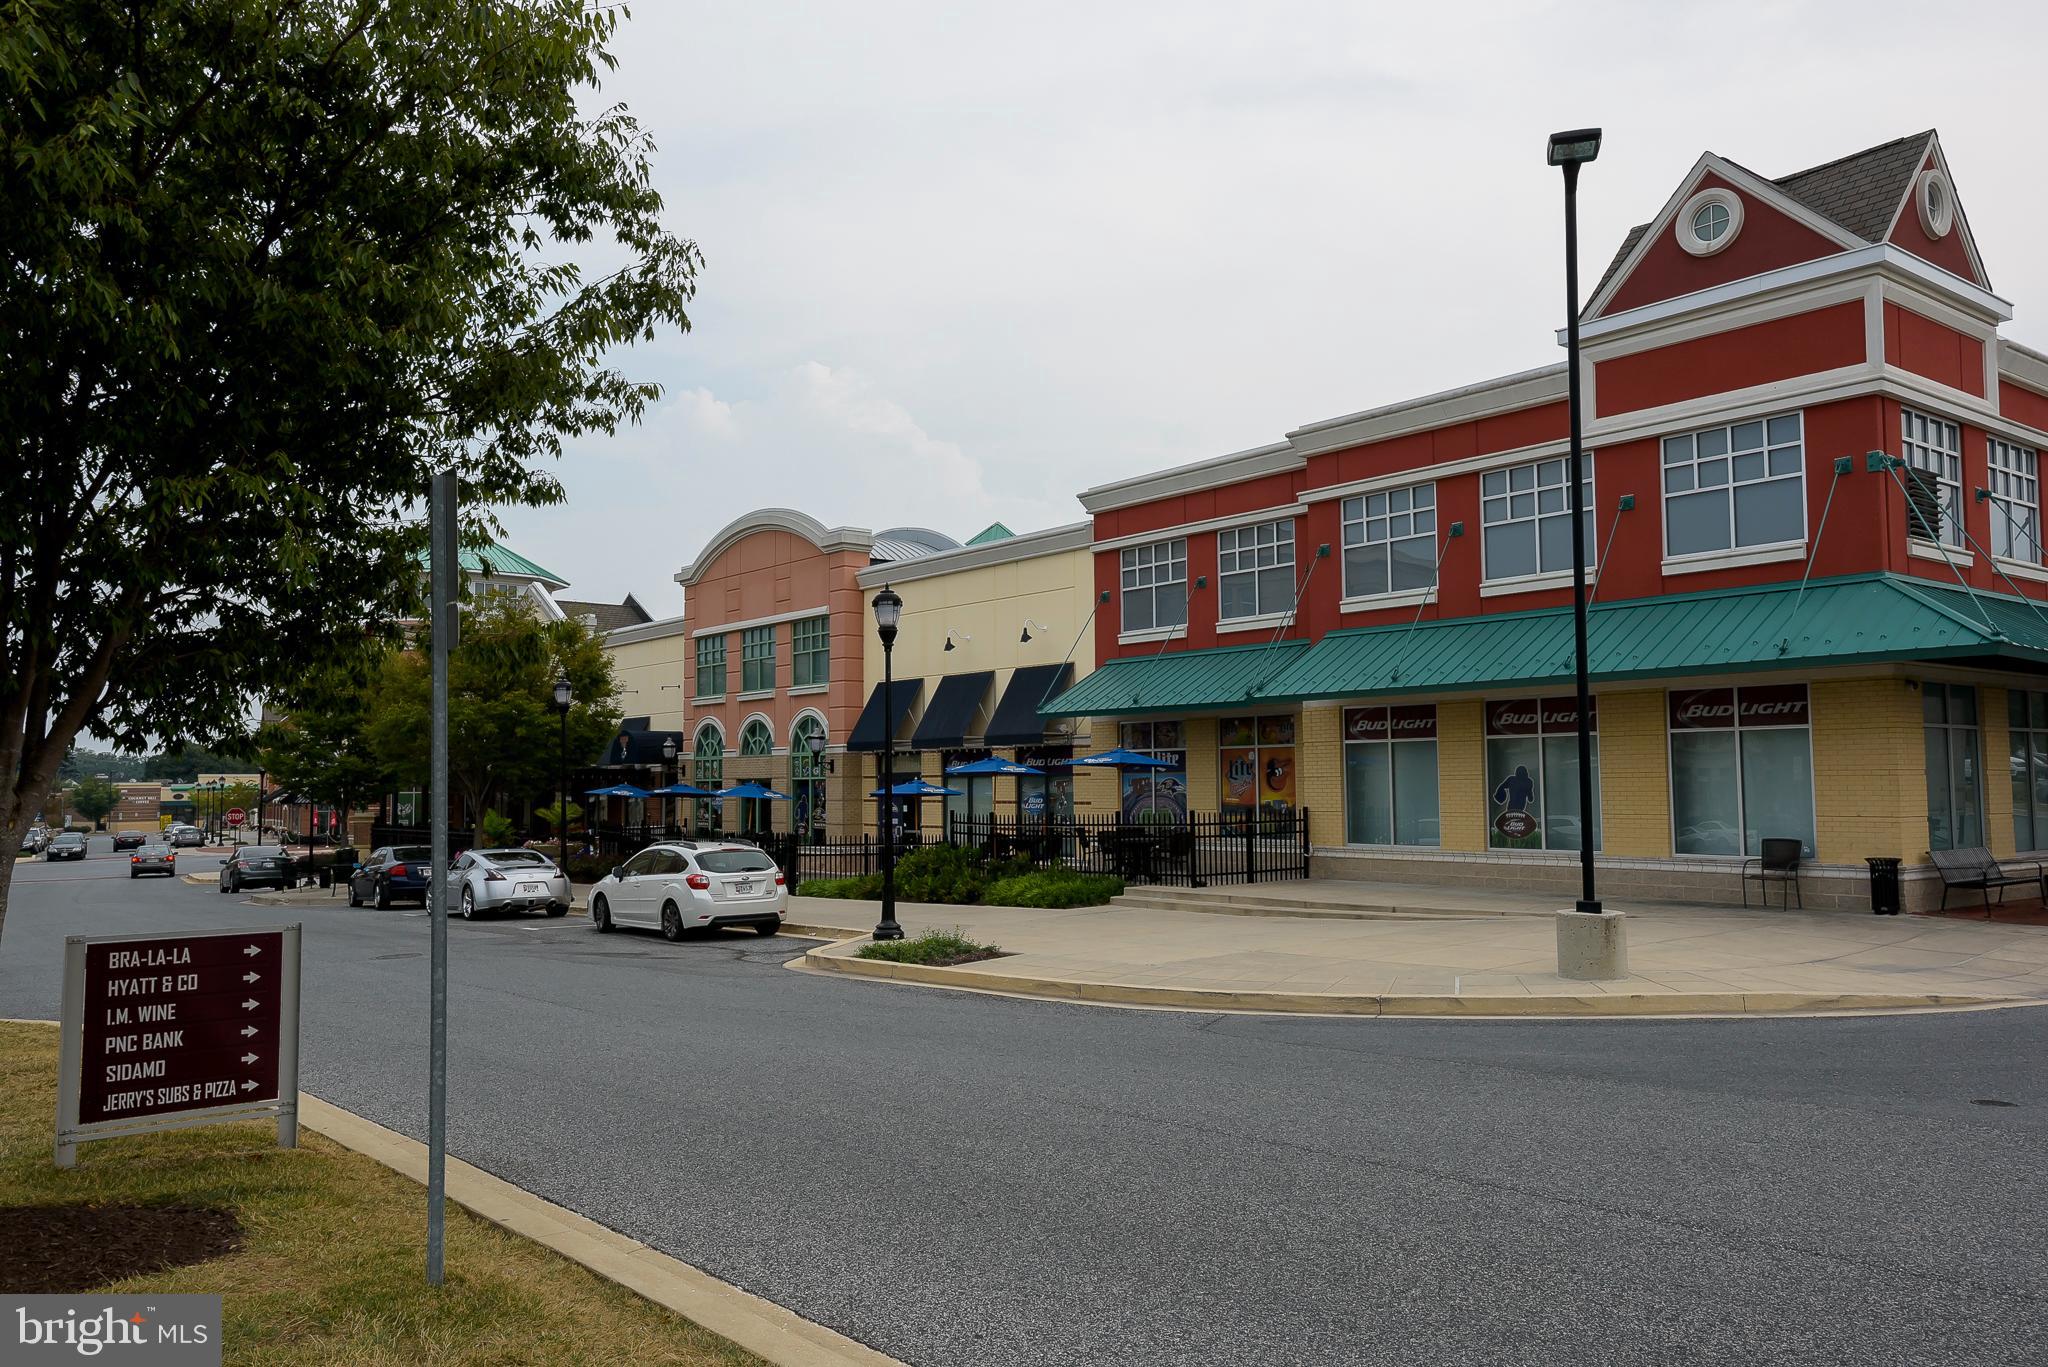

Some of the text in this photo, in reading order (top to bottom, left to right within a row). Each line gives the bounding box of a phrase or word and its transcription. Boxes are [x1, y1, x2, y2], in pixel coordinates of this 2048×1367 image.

[1500, 713, 1538, 725] BUD
[1687, 701, 1808, 717] BUD LIGHT
[1356, 718, 1436, 731] BUD LIGHT
[1026, 757, 1046, 767] BUD
[227, 812, 244, 821] STOP
[109, 946, 191, 969] BRA-LA-LA
[108, 974, 198, 997] HYATT & CO
[106, 1003, 177, 1026] I.M. WINE
[105, 1030, 184, 1055] PNC BANK
[105, 1060, 166, 1083] SIDAMO
[102, 1080, 236, 1112] JERRY'S SUBS & PIZZA
